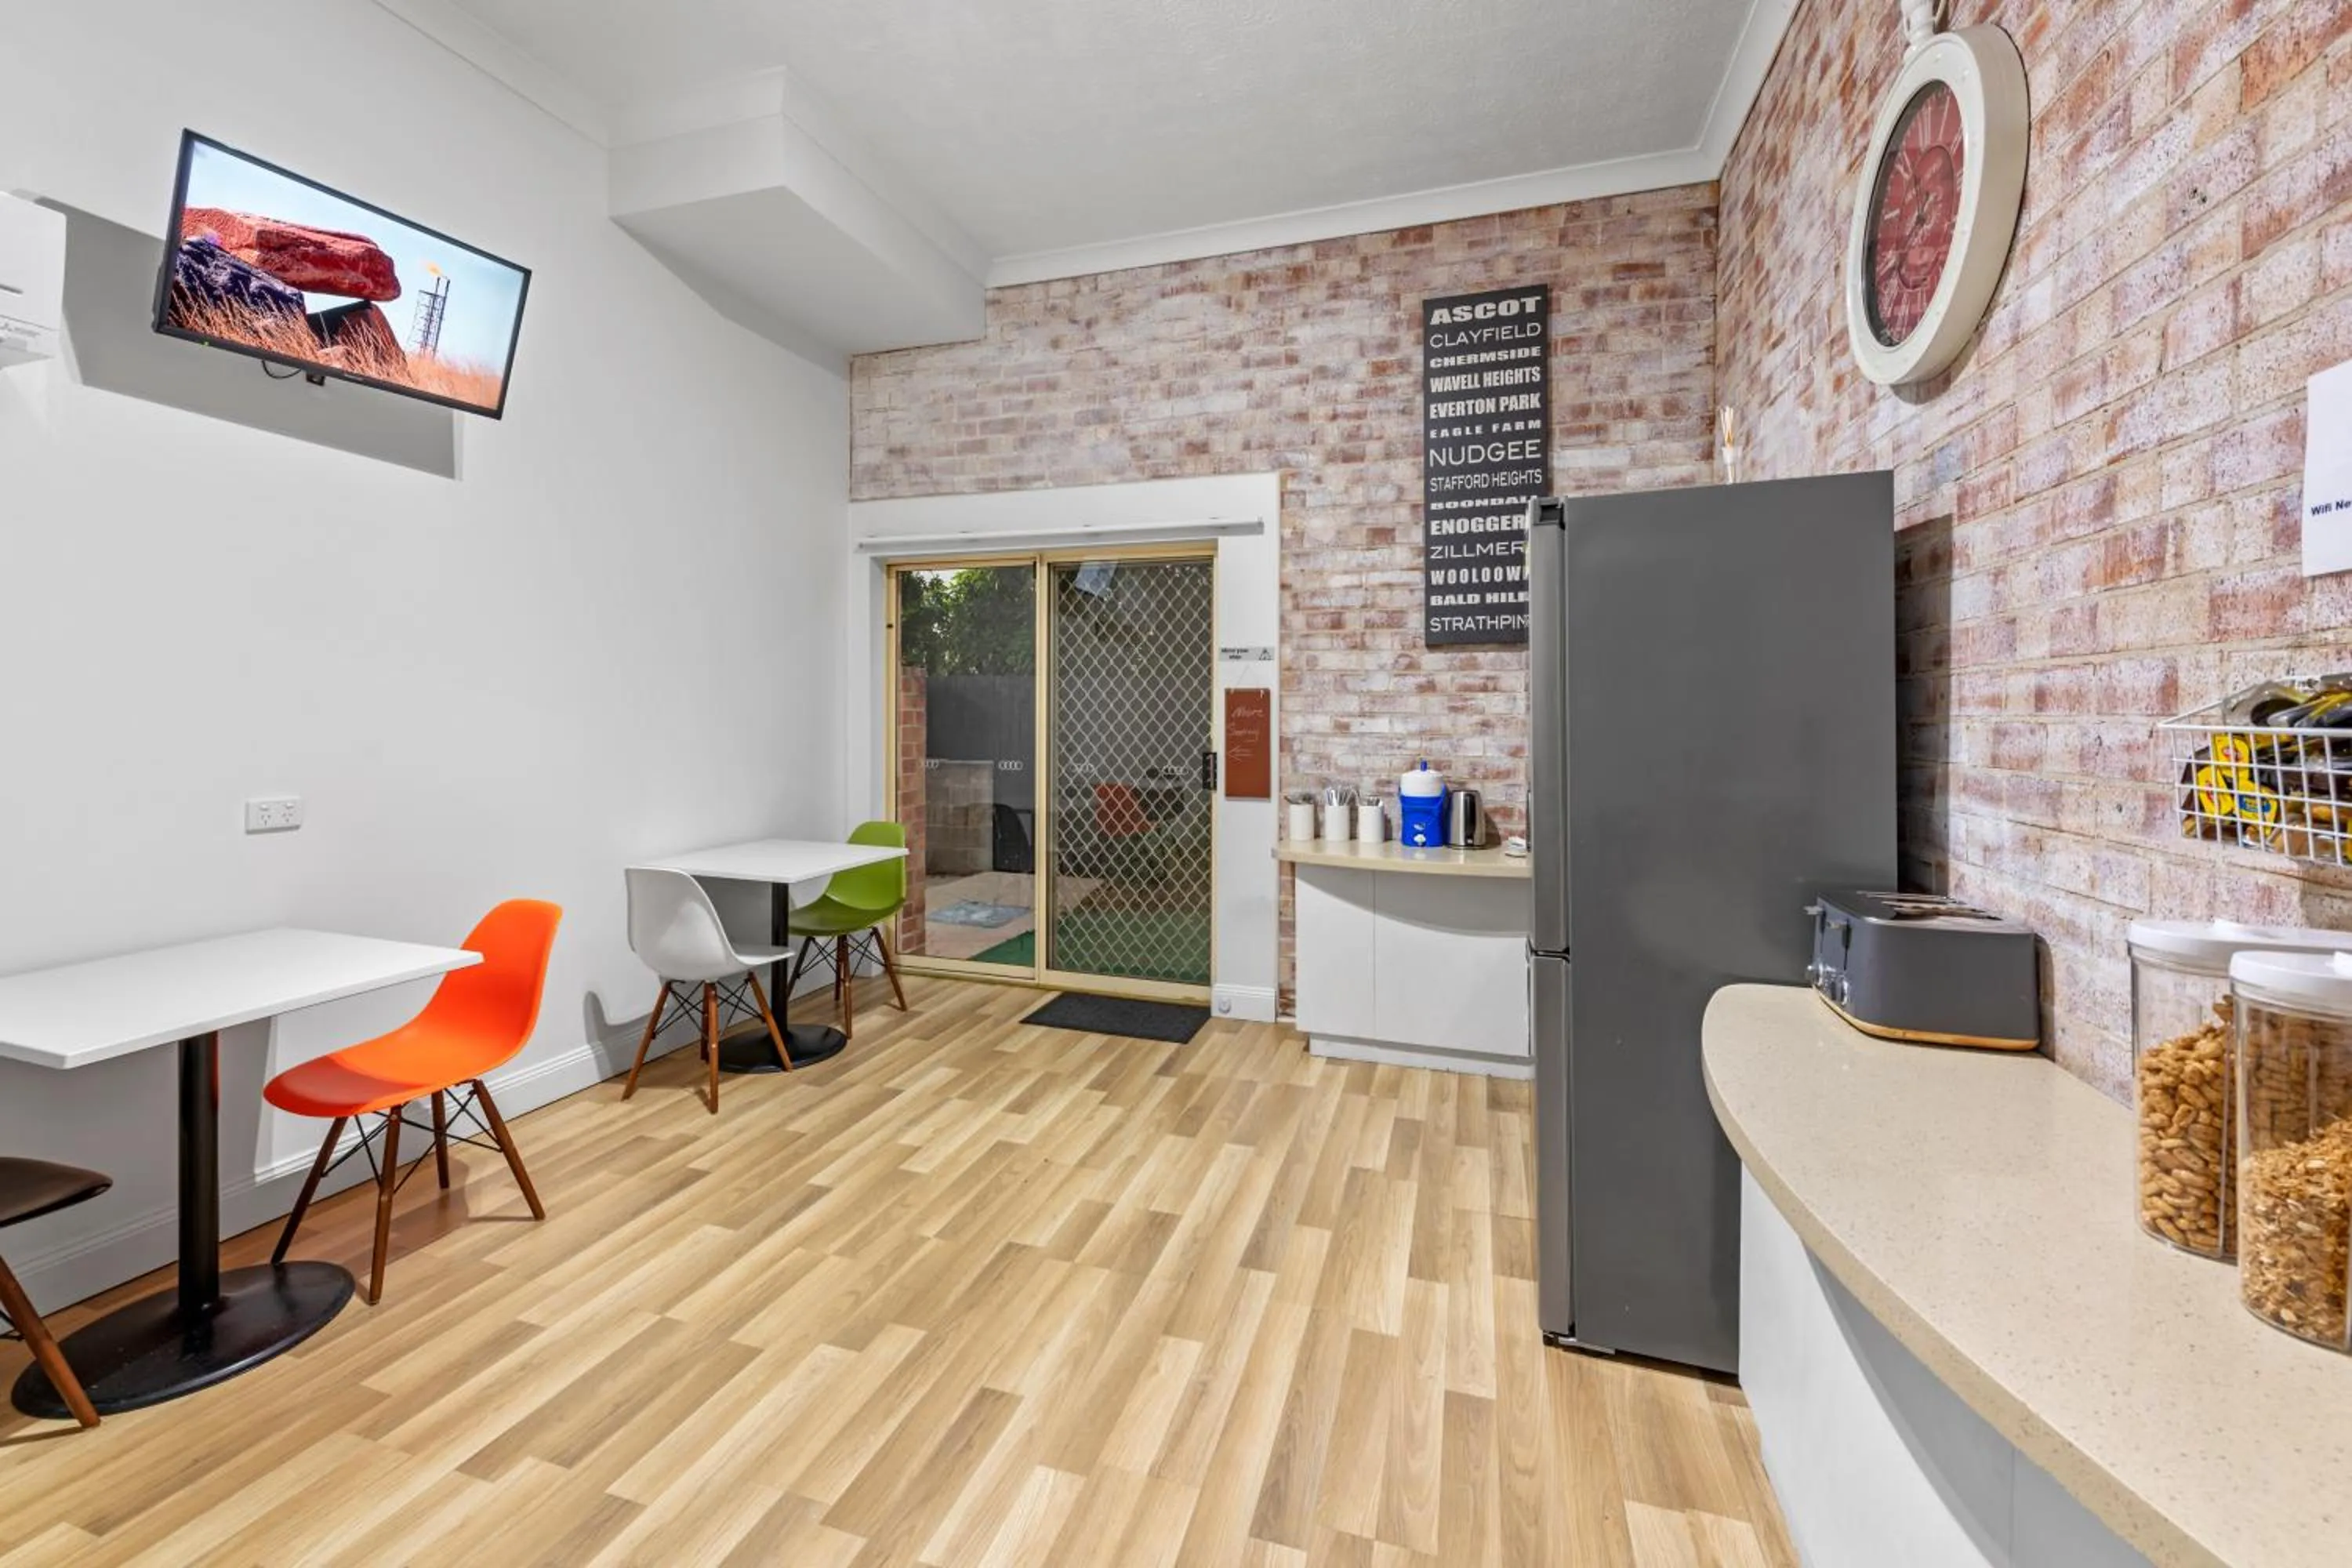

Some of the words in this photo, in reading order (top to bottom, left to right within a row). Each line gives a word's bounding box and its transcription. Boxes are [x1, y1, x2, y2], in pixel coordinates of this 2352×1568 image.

[1430, 296, 1541, 325] ASCOT
[1429, 322, 1541, 349] CLAYFIELD
[1429, 346, 1541, 368] CHERMSIDE
[1429, 372, 1480, 393] WAVELL
[1483, 366, 1541, 388] HEIGHTS
[1429, 397, 1497, 419] EVERTON
[1499, 393, 1541, 412] PARK
[1430, 424, 1483, 439] EAGLE
[1492, 419, 1541, 434] FARM
[1429, 439, 1541, 467] NUDGEE
[1429, 473, 1490, 492] STAFFORD
[1492, 469, 1542, 487] HEIGHTS
[2336, 499, 2352, 511] Ne
[1430, 514, 1530, 535] ENOGGER
[1430, 540, 1528, 560] ZILLMER
[1429, 593, 1481, 606] BALD
[1486, 591, 1529, 604] HILL
[1429, 614, 1530, 633] STRATHPIN
